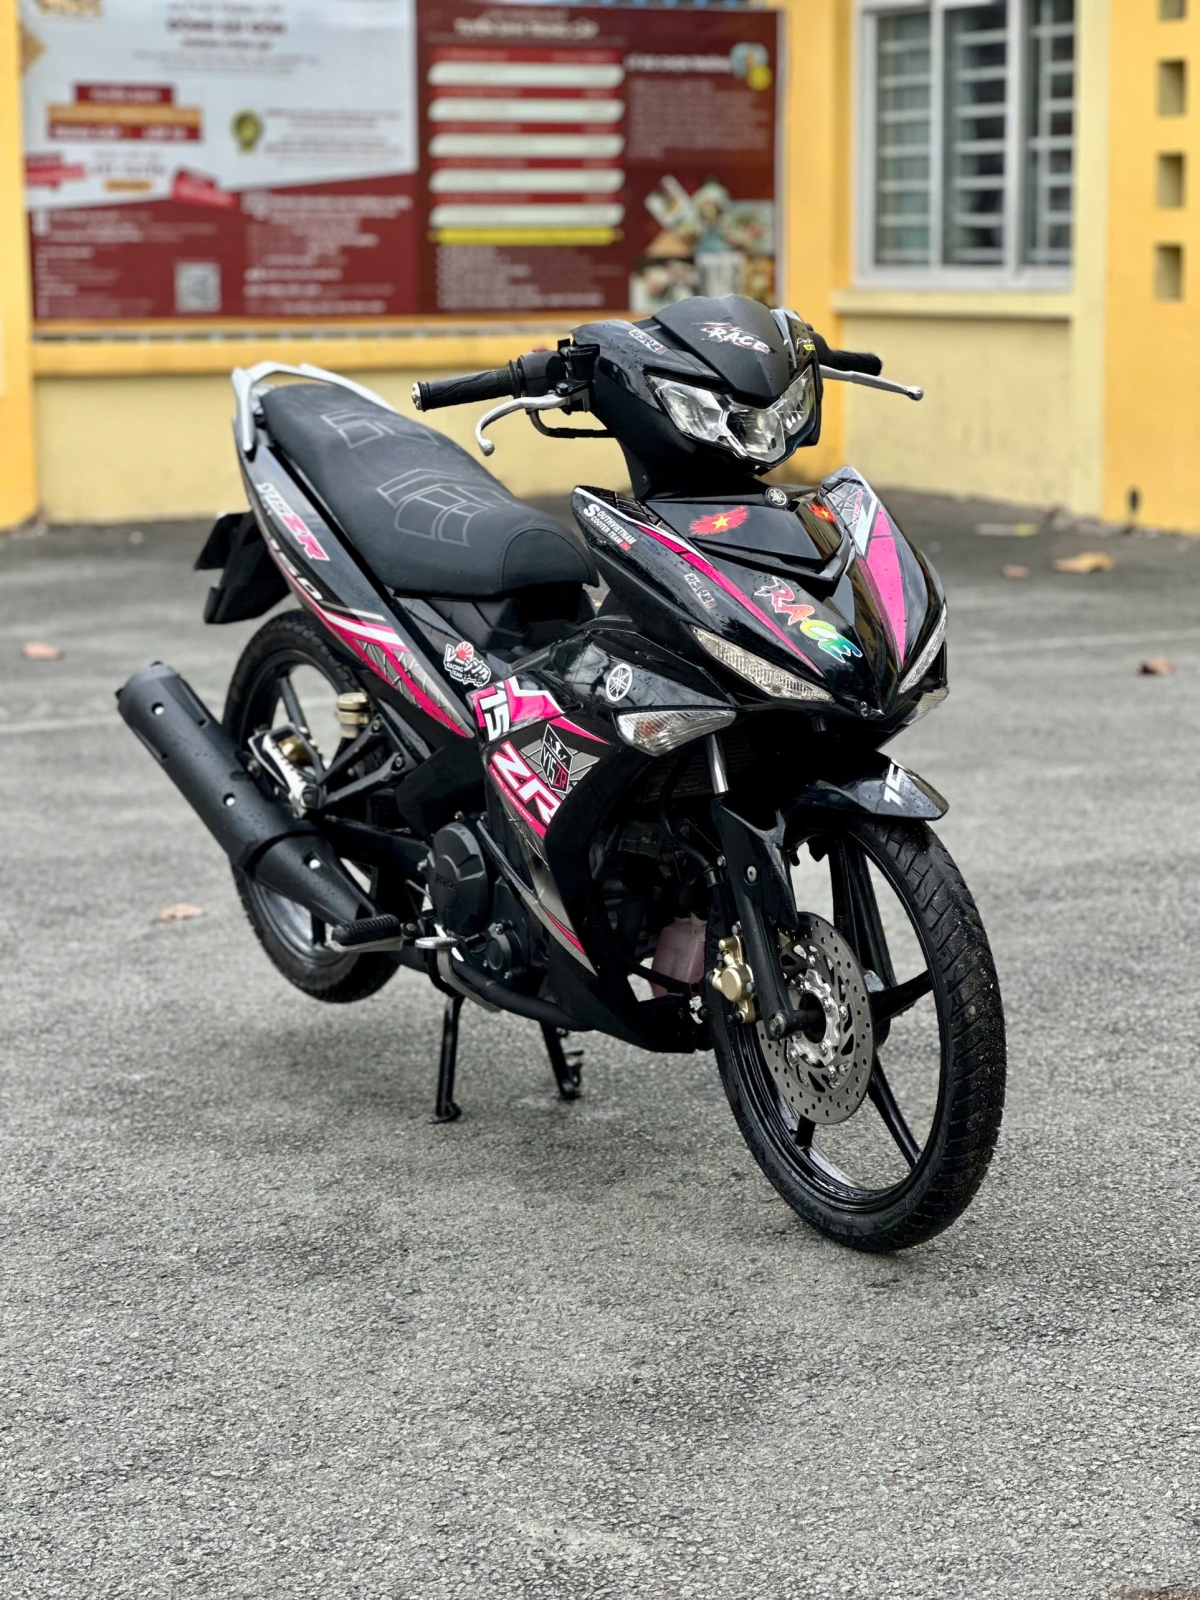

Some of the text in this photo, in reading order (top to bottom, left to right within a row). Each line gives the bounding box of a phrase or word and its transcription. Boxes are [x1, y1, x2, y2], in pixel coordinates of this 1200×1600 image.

[702, 326, 770, 354] RACE
[608, 530, 624, 545] TEAM
[754, 575, 863, 663] RACE
[446, 662, 465, 673] RACING
[451, 670, 464, 679] TEAM
[542, 746, 569, 789] Y15ZR
